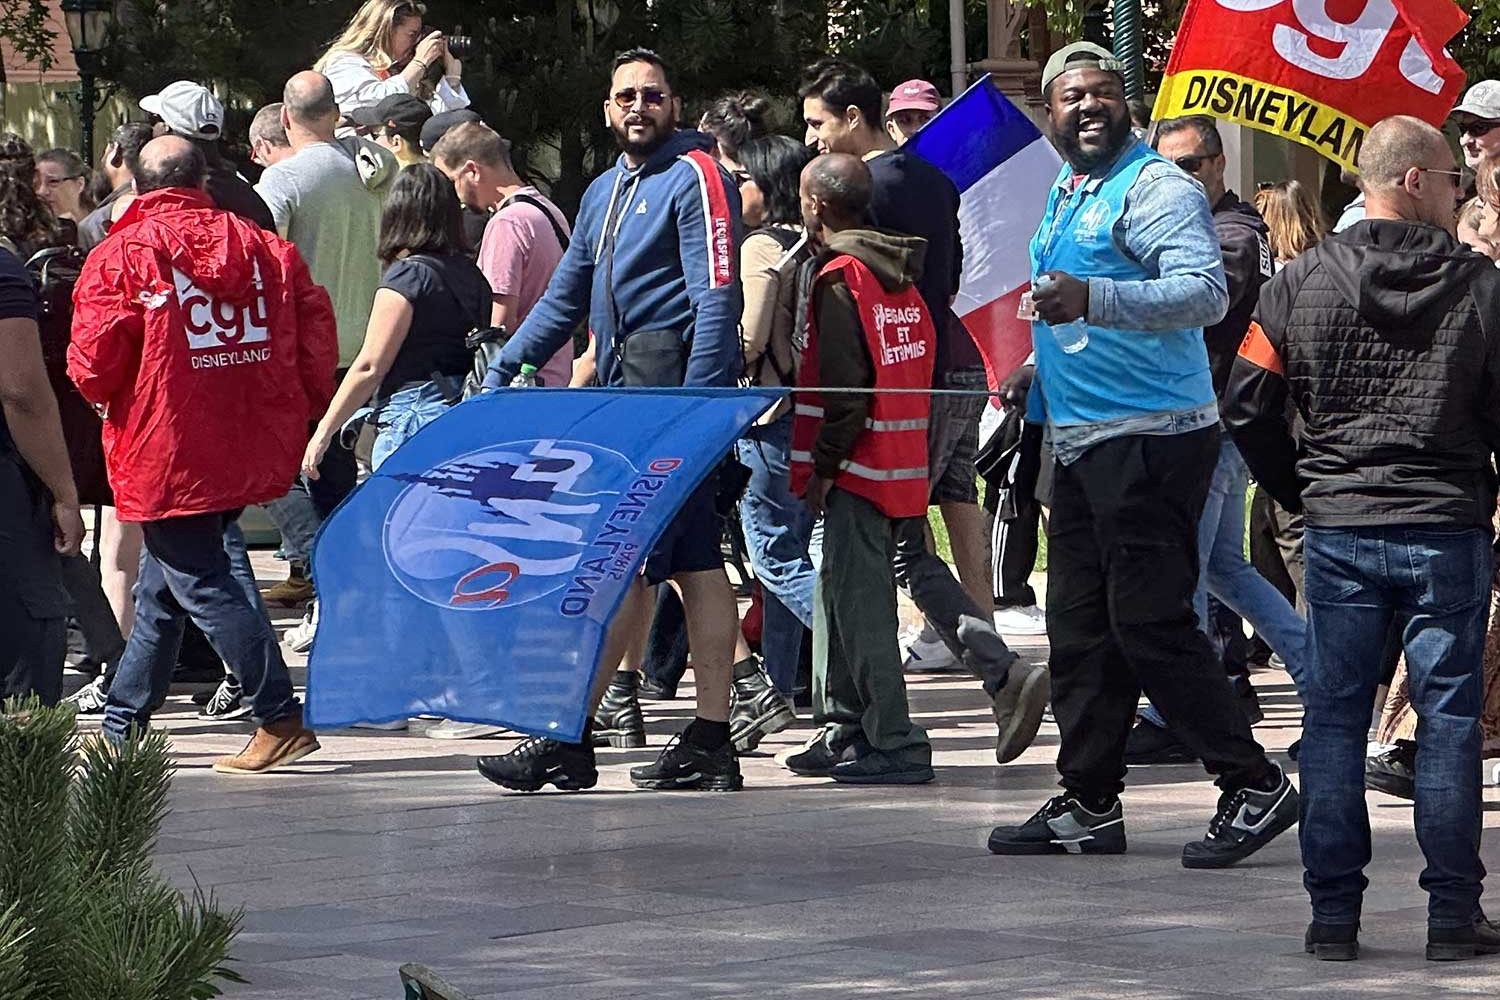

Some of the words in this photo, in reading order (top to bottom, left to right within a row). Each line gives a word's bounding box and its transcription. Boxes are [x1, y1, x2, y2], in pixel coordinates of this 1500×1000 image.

[1183, 75, 1369, 168] DISNEYLAN
[897, 326, 910, 343] ET
[191, 348, 271, 369] DISNEYLAND
